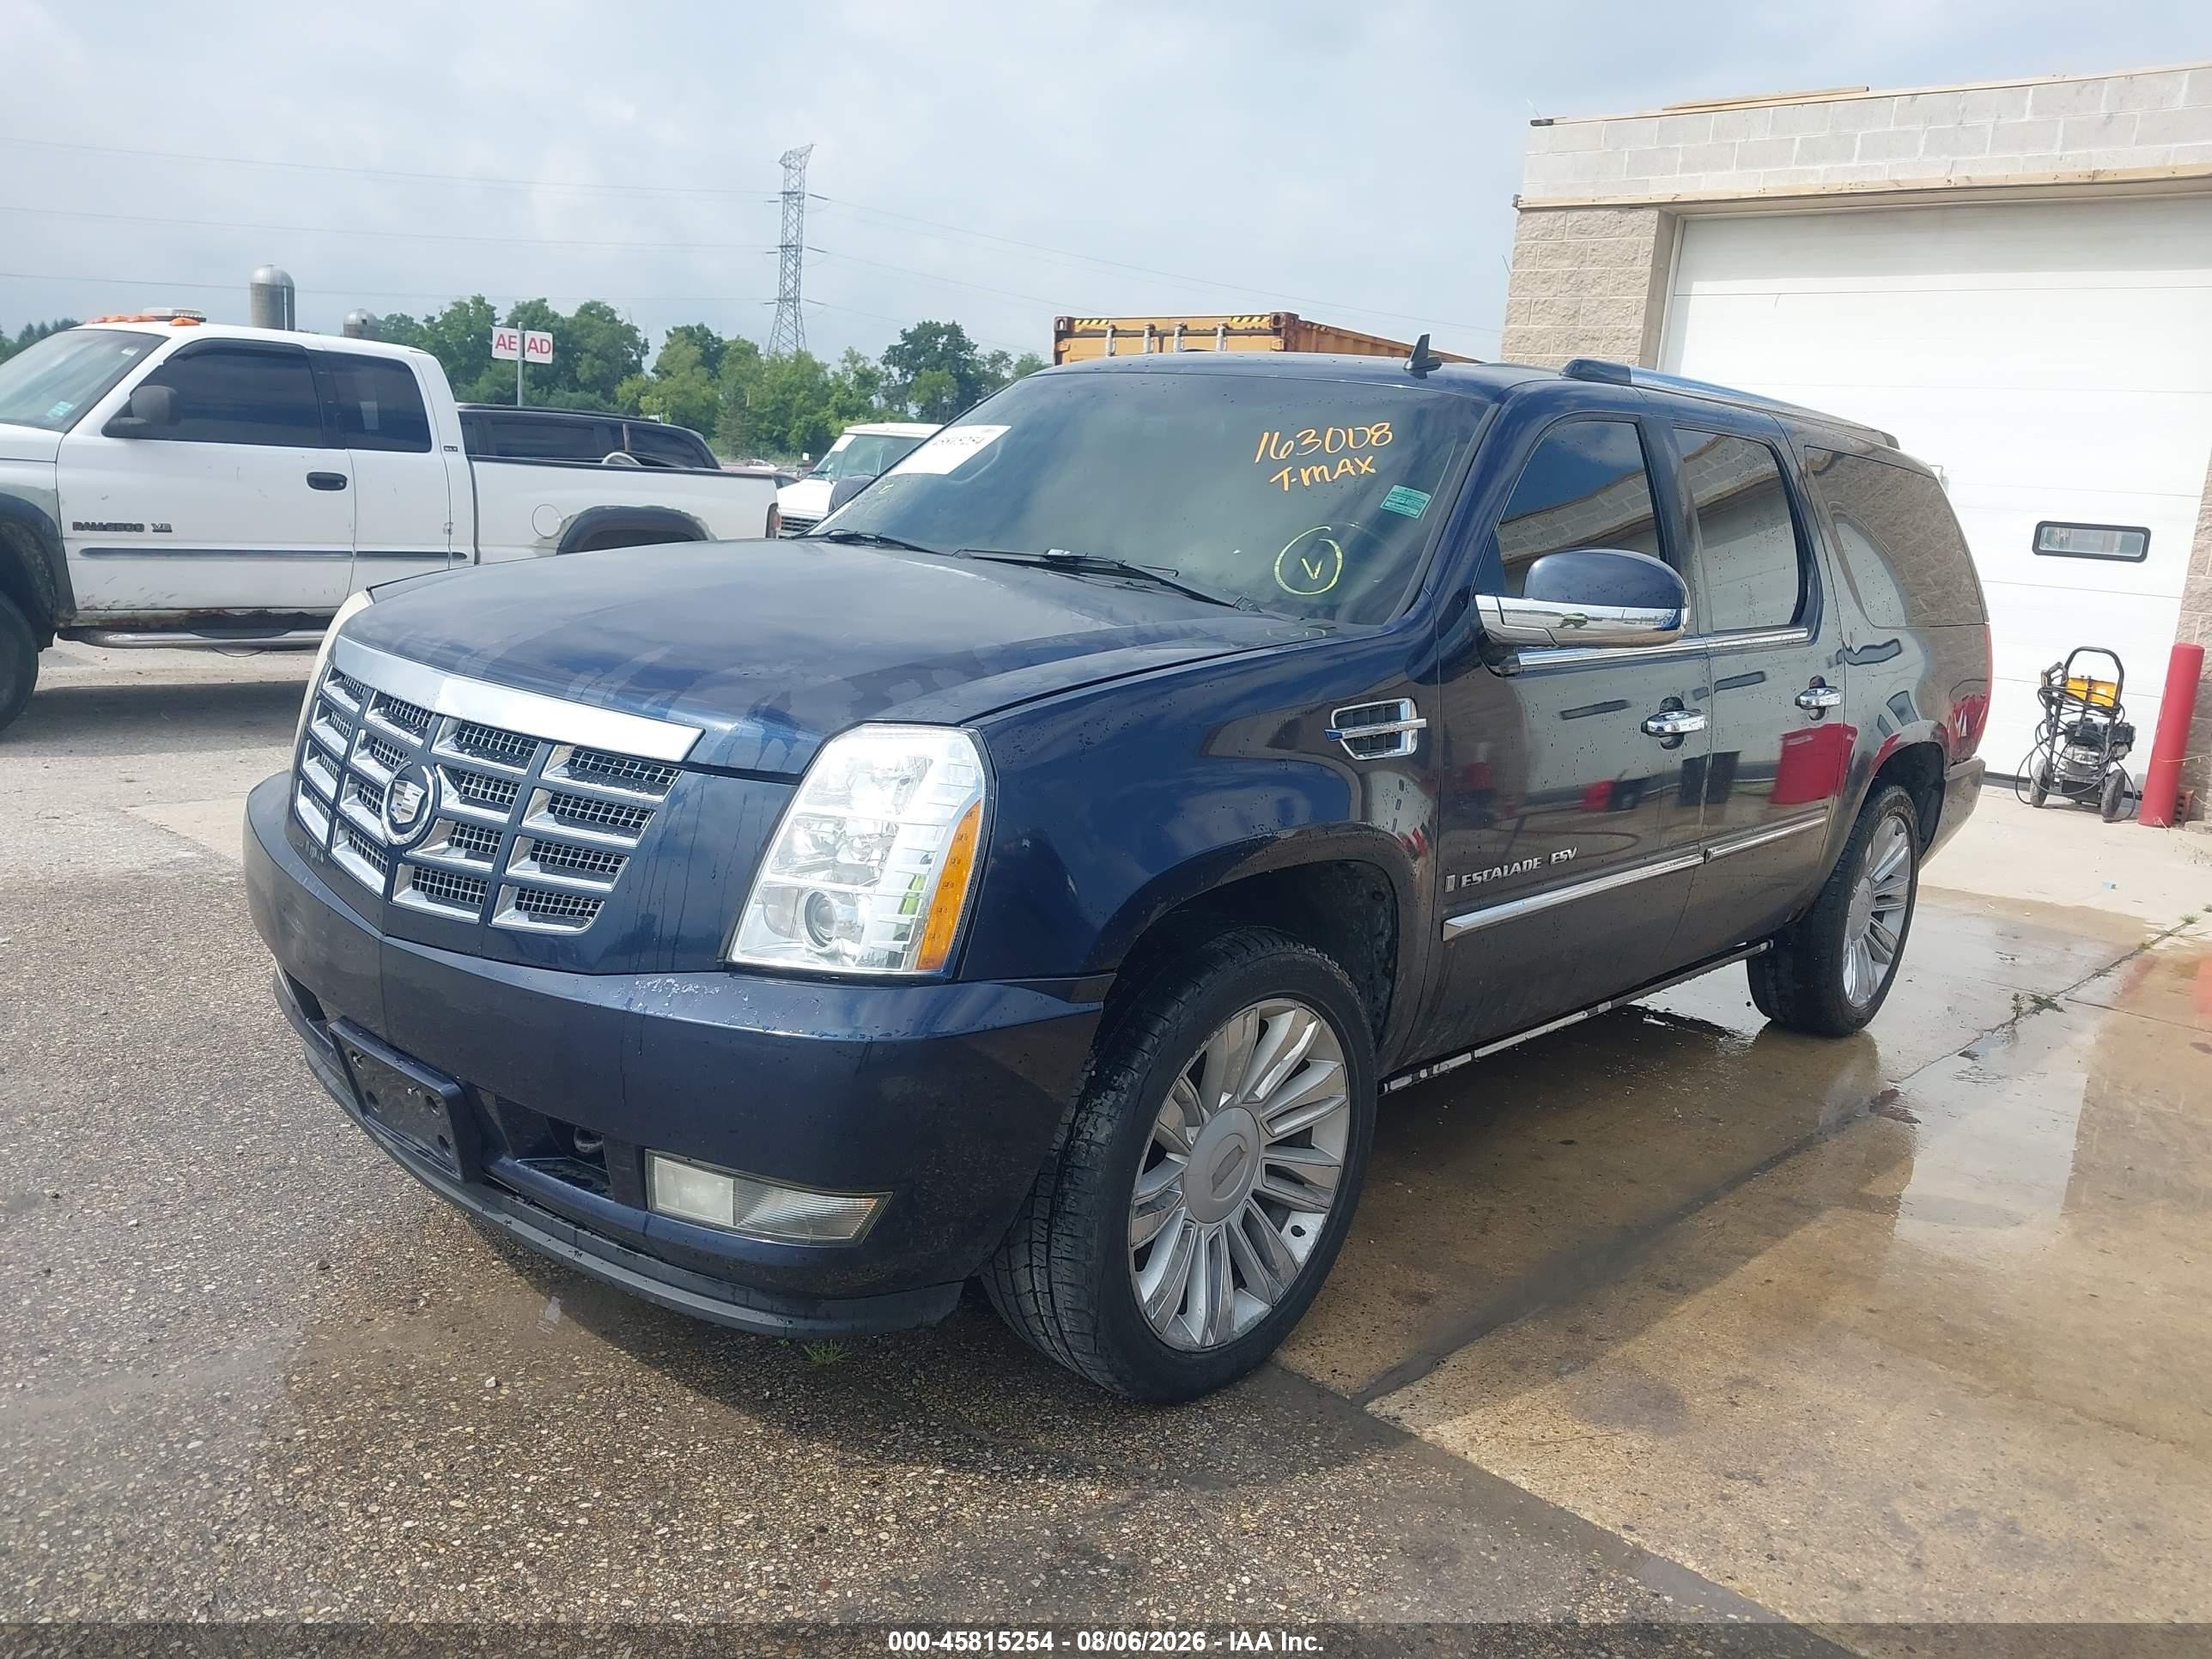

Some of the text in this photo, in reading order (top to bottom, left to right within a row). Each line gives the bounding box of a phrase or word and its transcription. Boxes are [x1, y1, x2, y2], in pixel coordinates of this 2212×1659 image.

[495, 333, 551, 354] AE AD
[72, 521, 103, 532] RAM
[1460, 847, 1578, 889] ESCALADE ESV
